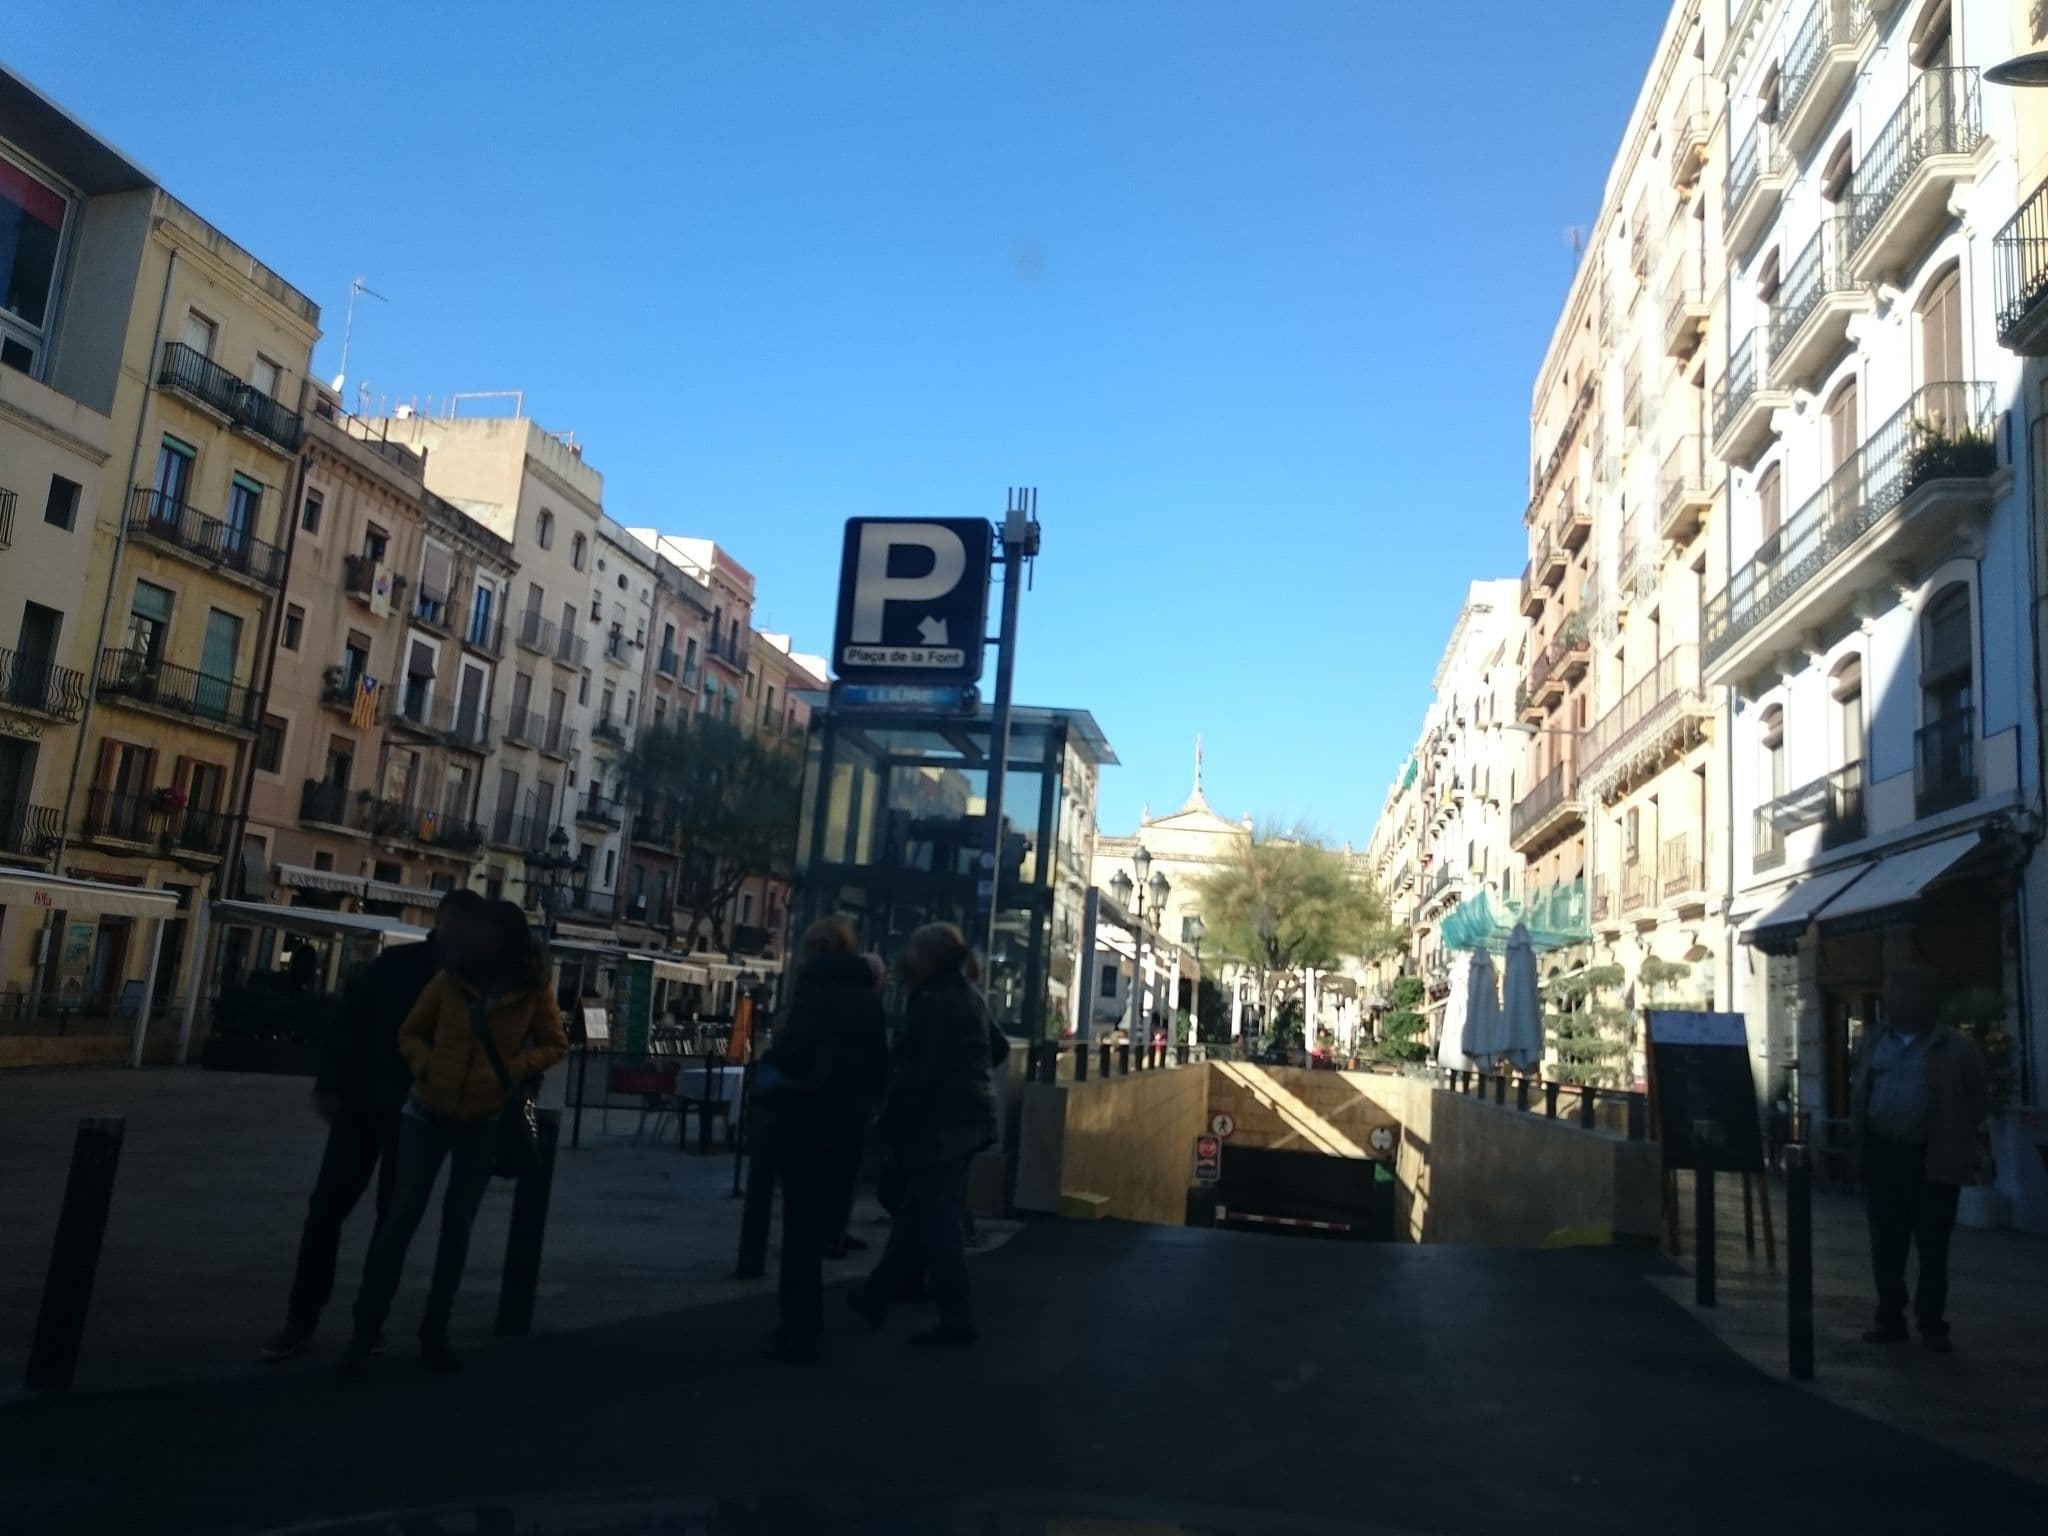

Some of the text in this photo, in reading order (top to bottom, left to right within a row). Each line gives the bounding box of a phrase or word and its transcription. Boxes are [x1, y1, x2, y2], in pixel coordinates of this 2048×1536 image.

[850, 522, 966, 644] P
[847, 648, 960, 664] Plaça de la Font
